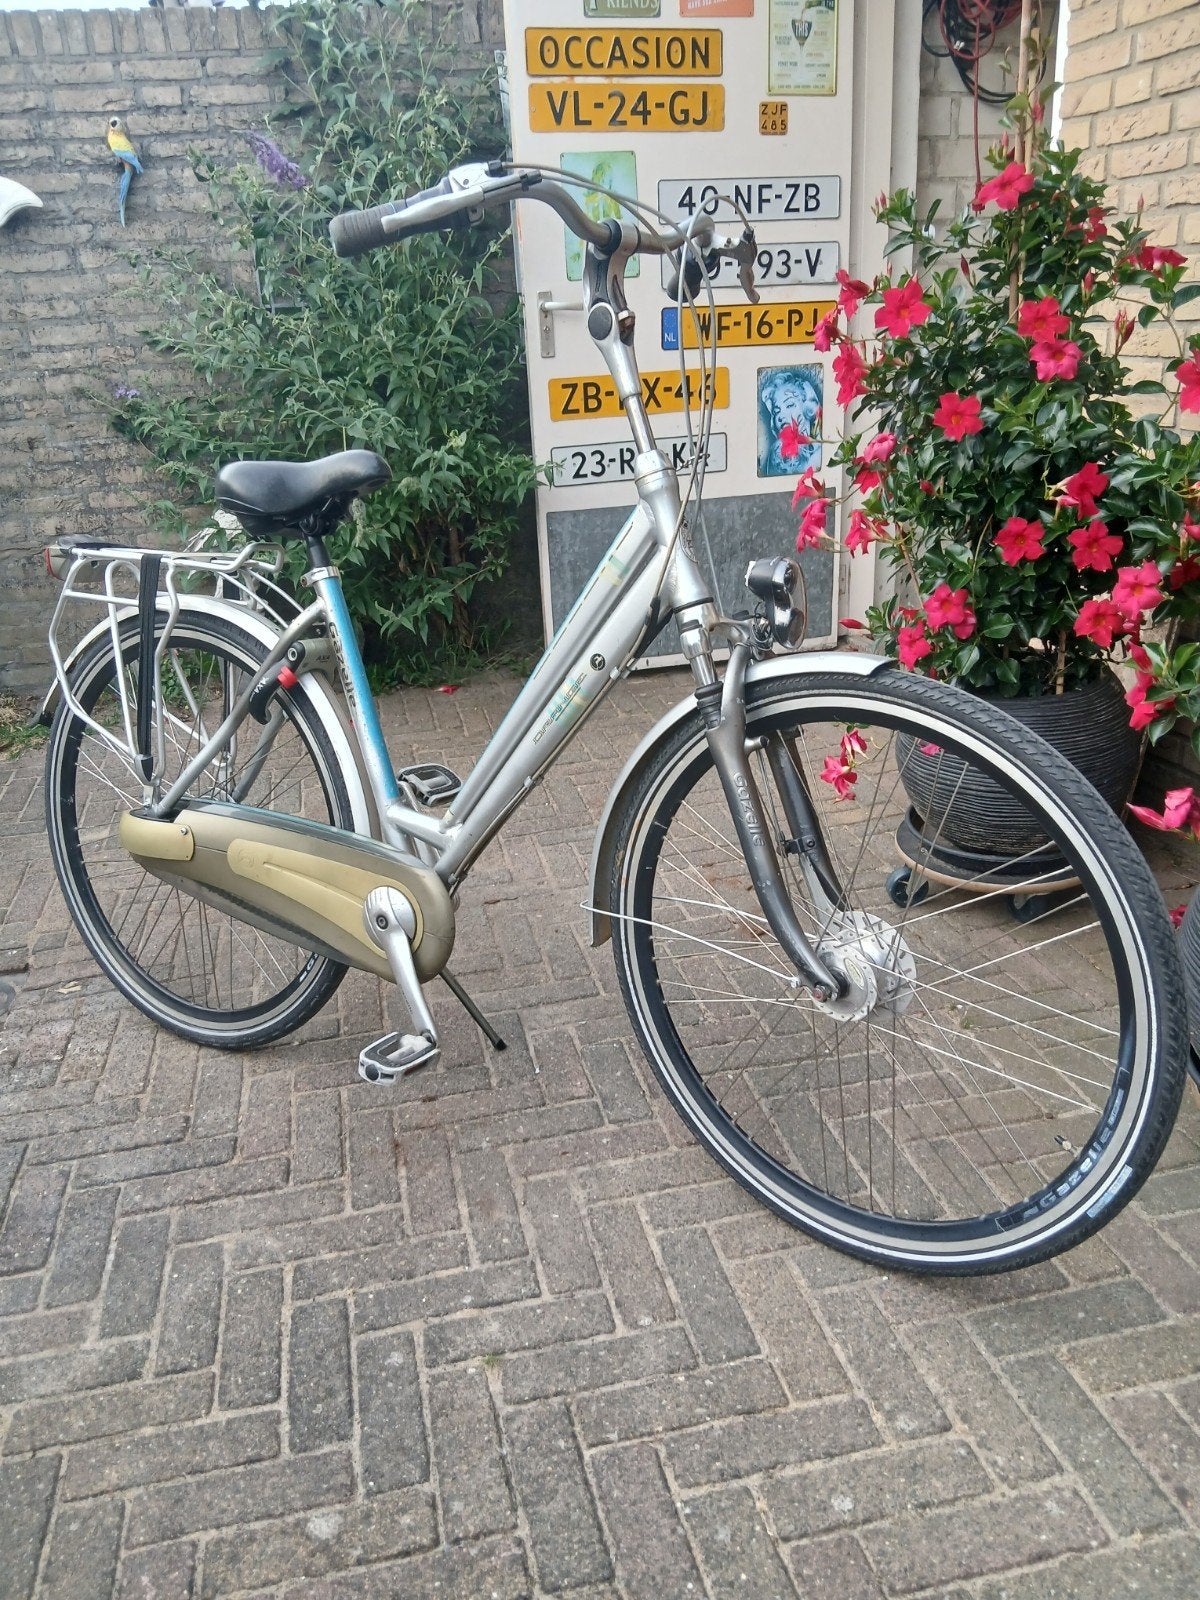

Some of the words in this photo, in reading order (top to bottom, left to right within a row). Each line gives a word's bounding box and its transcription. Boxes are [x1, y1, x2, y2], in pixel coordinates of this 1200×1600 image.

[539, 36, 710, 69] OCCASION
[546, 90, 709, 126] VL-24-GJ
[761, 104, 787, 115] ZJF
[761, 119, 787, 130] 485
[678, 183, 821, 216] 40-NF-ZB
[665, 334, 676, 342] NL
[561, 373, 717, 415] ZB-X-46
[733, 772, 766, 846] Gazelle
